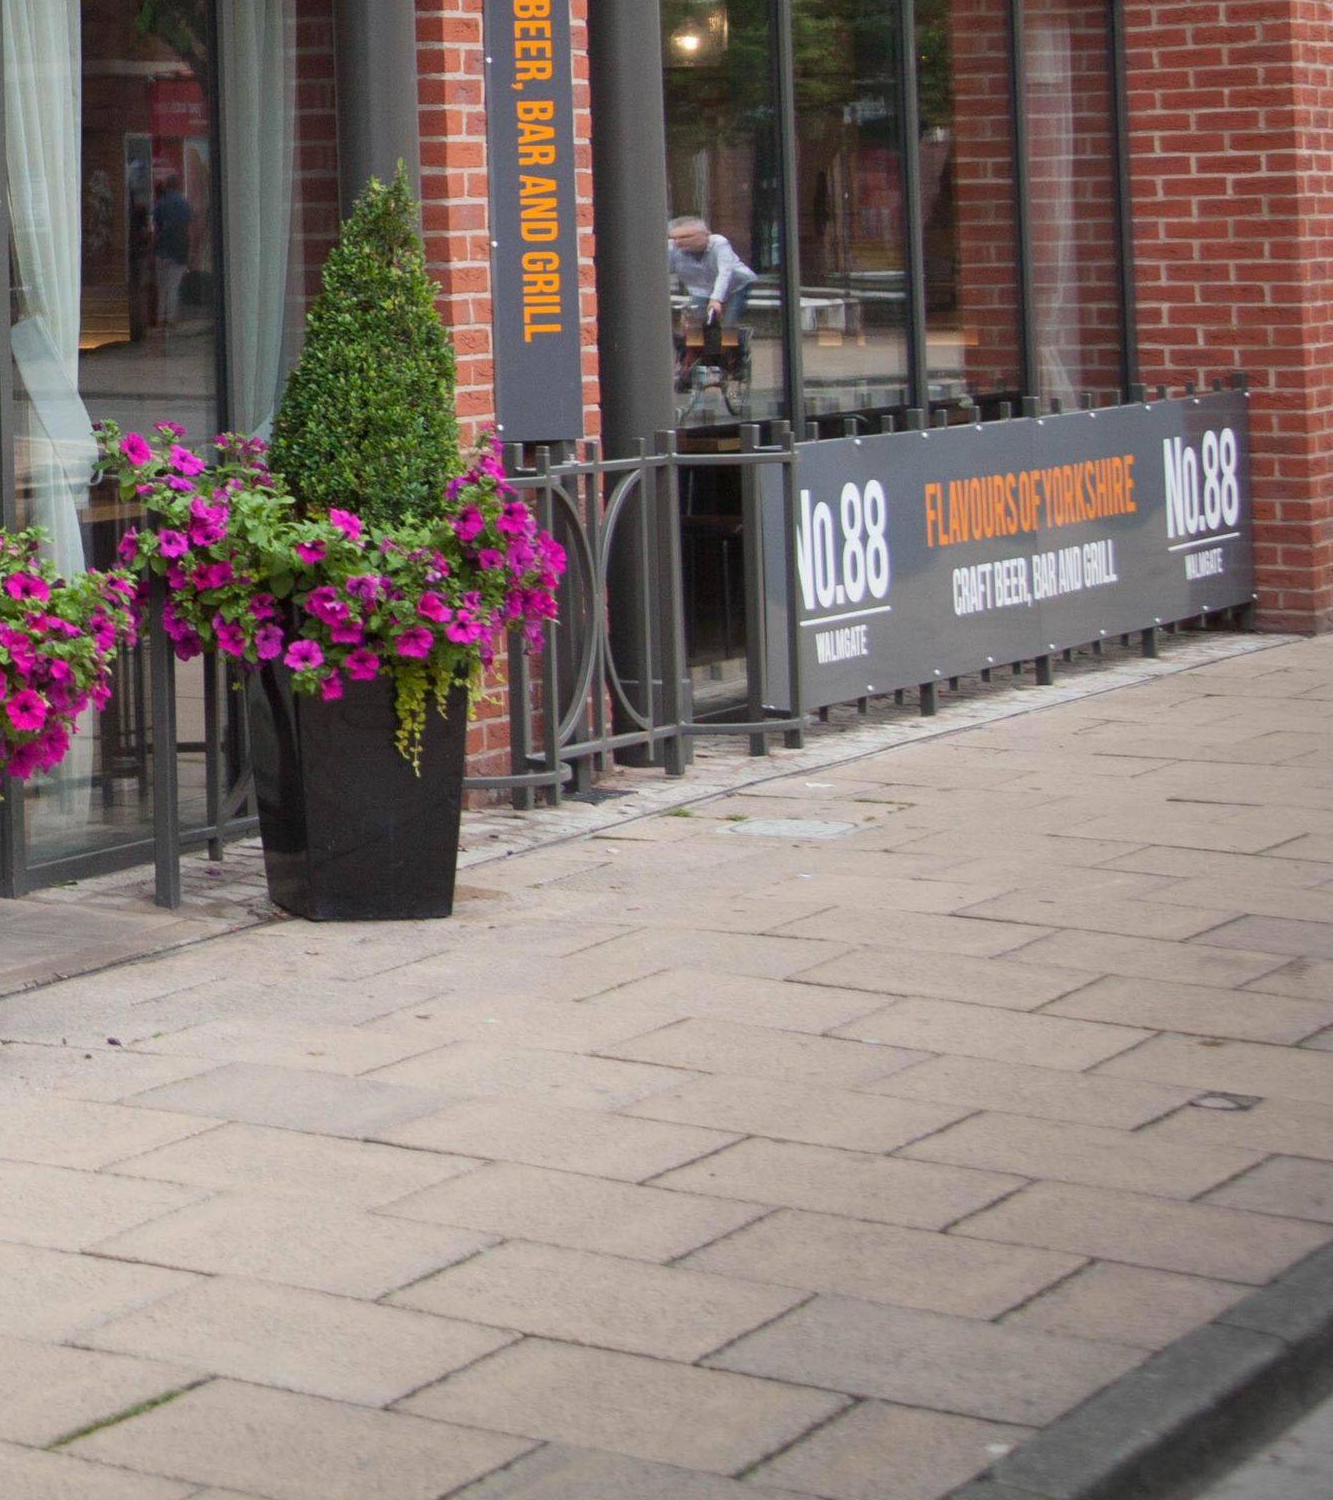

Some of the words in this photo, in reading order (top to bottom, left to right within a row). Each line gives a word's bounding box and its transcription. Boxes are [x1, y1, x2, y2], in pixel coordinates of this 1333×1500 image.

[516, 100, 556, 165] BAR
[519, 175, 559, 242] AND
[521, 251, 562, 343] GRILL
[925, 472, 1018, 548] FLAVOURS
[1019, 470, 1041, 533] OF
[1042, 454, 1137, 528] YORKSHIRE
[1163, 428, 1239, 539] No.88
[953, 563, 993, 616] CRAFT
[994, 557, 1032, 607] BEER,
[1033, 552, 1057, 600] BAR
[1059, 546, 1081, 593] AND
[1083, 539, 1118, 587] GRILL
[1185, 548, 1223, 581] WALMGATE
[815, 624, 868, 664] WALMGATE
